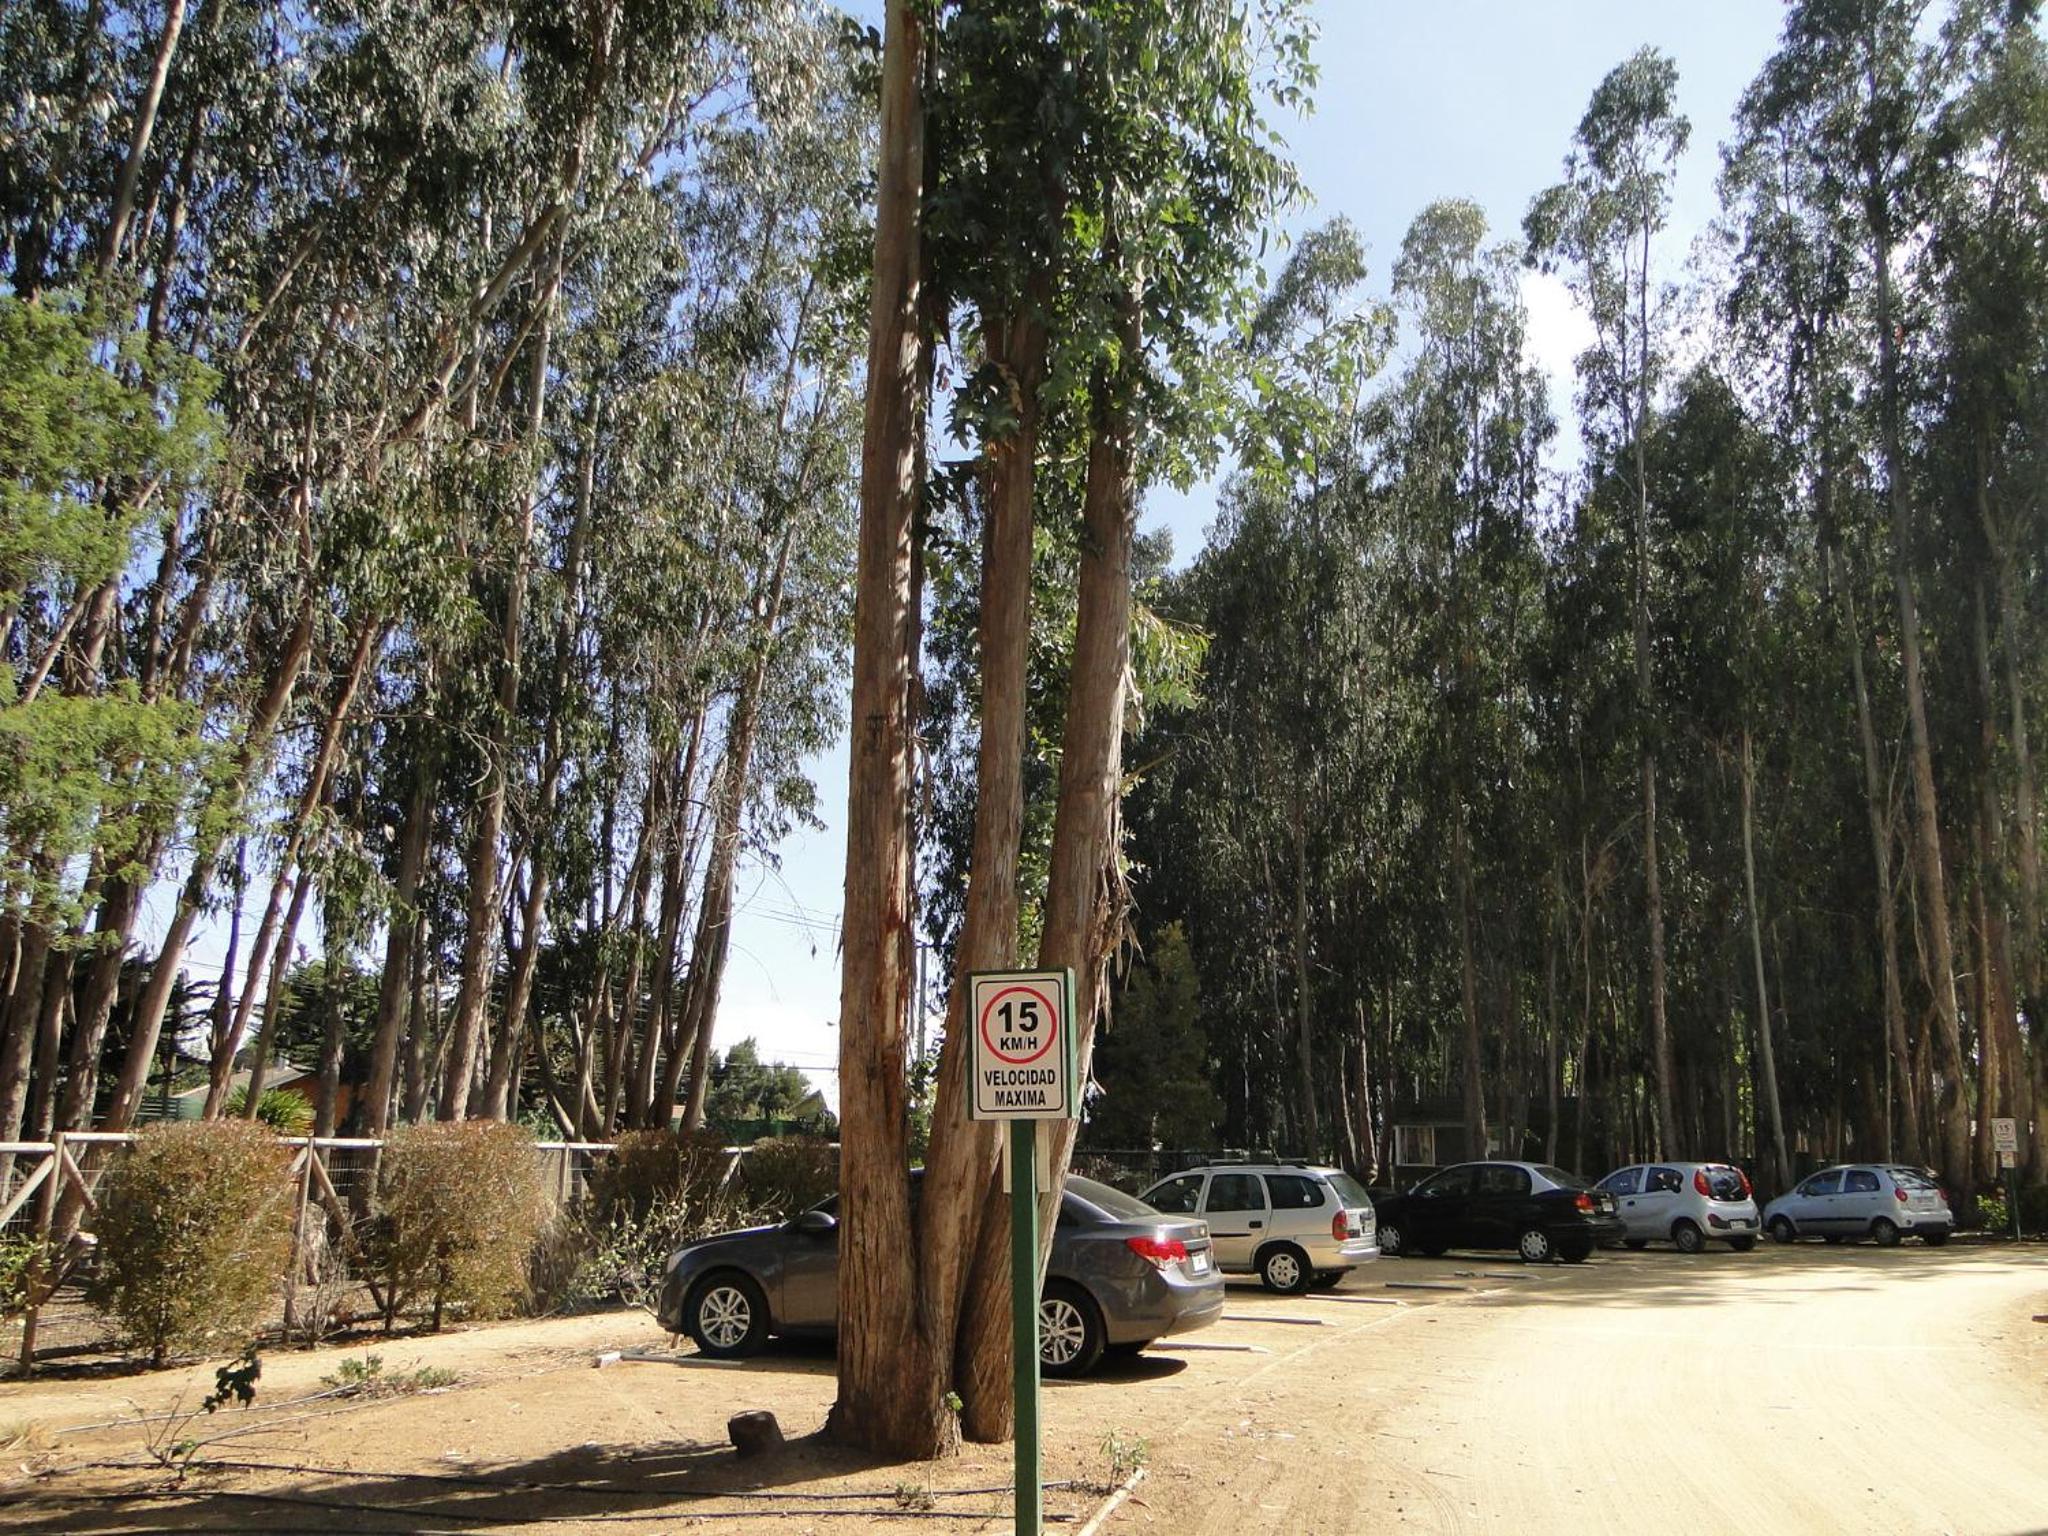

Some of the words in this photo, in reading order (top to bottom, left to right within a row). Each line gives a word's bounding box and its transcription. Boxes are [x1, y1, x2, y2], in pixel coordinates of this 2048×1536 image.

[997, 1001, 1039, 1033] 15
[1000, 1036, 1037, 1051] KM/H
[984, 1068, 1056, 1086] VELOCIDAD
[995, 1090, 1046, 1107] MAXIMA
